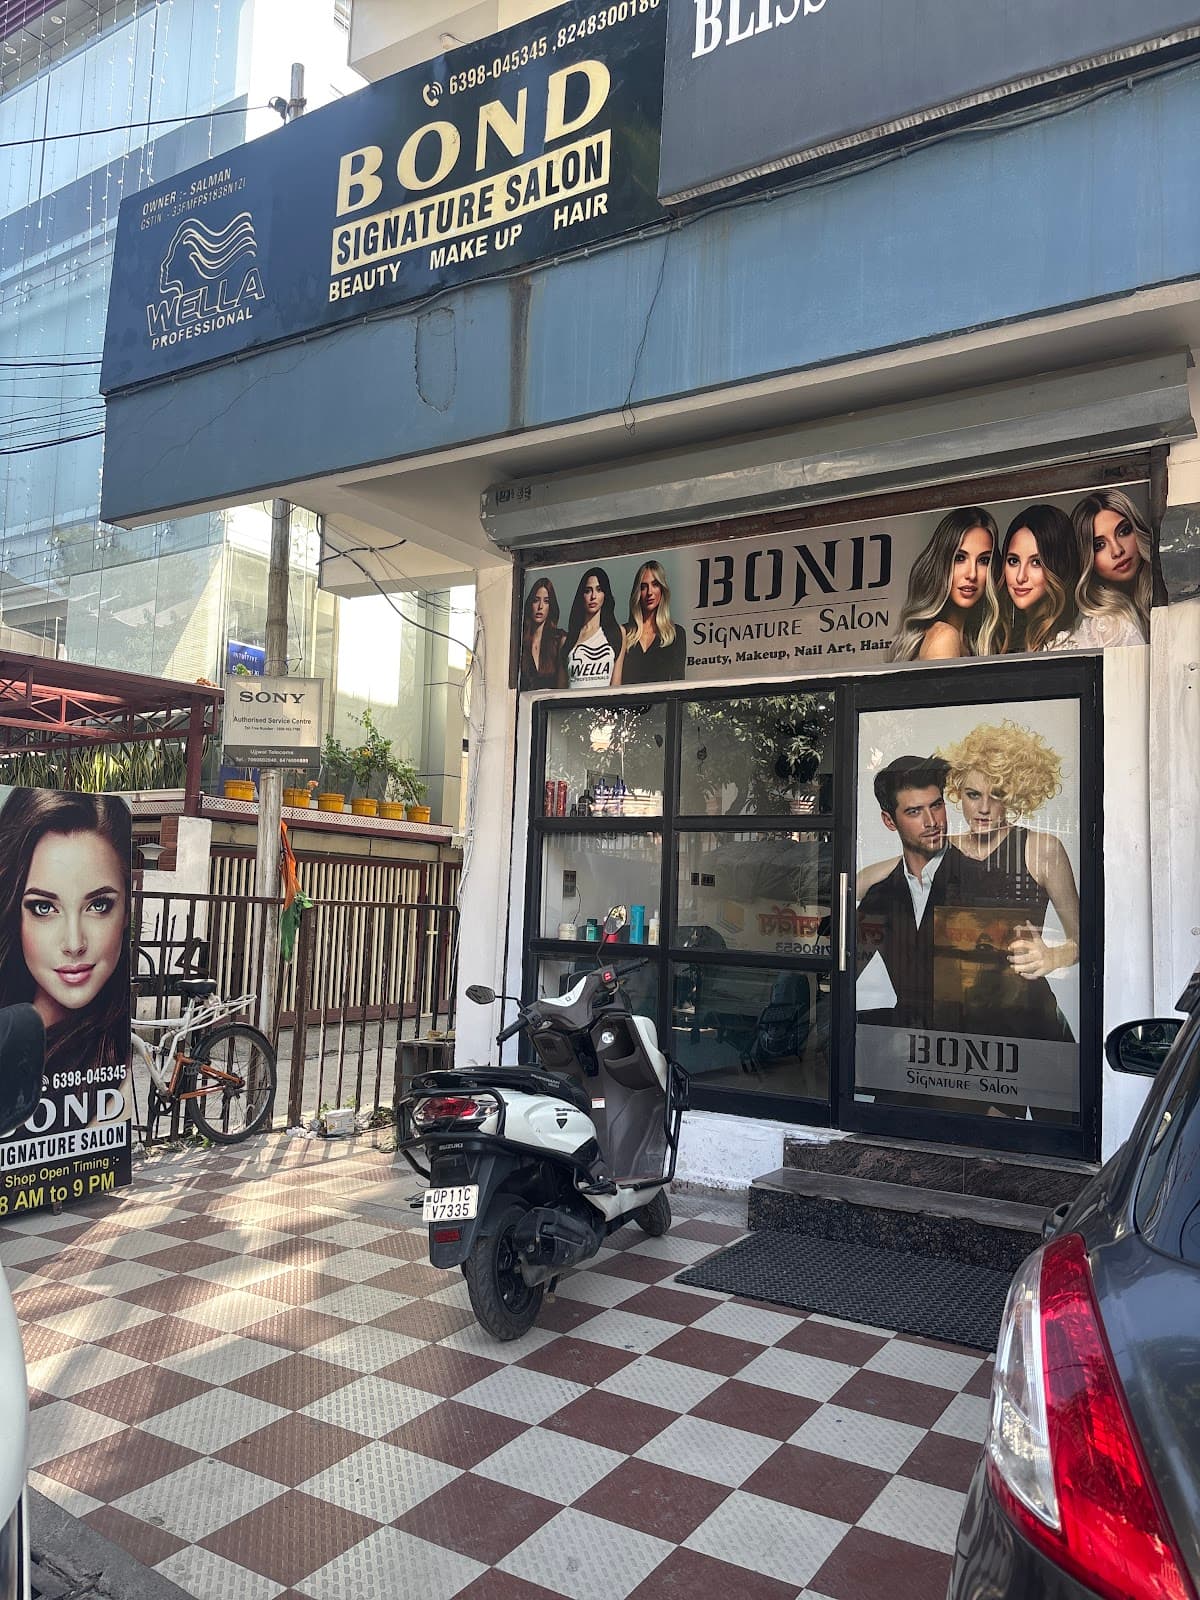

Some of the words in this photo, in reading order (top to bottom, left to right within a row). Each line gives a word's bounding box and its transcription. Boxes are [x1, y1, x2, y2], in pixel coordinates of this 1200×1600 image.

[691, 0, 827, 59] BLI
[449, 36, 547, 95] 6398-045345
[336, 59, 611, 217] BOND
[142, 191, 177, 216] OWNER
[190, 168, 232, 195] SALMAN
[337, 183, 495, 266] SIGNATURE
[504, 140, 604, 212] SALON
[140, 215, 162, 230] GSTIN
[329, 262, 401, 302] BEAUTY
[429, 235, 488, 270] MAKE
[494, 224, 523, 250] UP
[553, 193, 608, 231] HAIR
[147, 268, 265, 336] WELLA
[152, 307, 253, 350] PROFESSIONAL
[693, 533, 893, 608] BOND
[571, 662, 610, 678] WELLA
[686, 654, 732, 667] Beauty,
[735, 649, 791, 663] Makeup,
[794, 644, 823, 657] Nail
[827, 642, 856, 655] Art,
[860, 639, 893, 651] Hair
[239, 691, 305, 704] SONY
[233, 716, 267, 724] Authorised
[268, 717, 291, 725] Service
[291, 717, 312, 725] Centre
[906, 1034, 1019, 1073] BOND
[52, 1064, 127, 1089] 6398-045345
[0, 1088, 124, 1138] OND
[81, 1126, 124, 1150] SALON
[5, 1173, 37, 1188] Shop
[39, 1165, 70, 1181] Open
[73, 1157, 109, 1173] Timing
[13, 1187, 44, 1210] AM
[50, 1185, 68, 1203] to
[73, 1179, 84, 1198] 9
[89, 1171, 115, 1194] PM
[432, 1203, 470, 1219] V7335
[433, 1188, 471, 1203] UP11C
